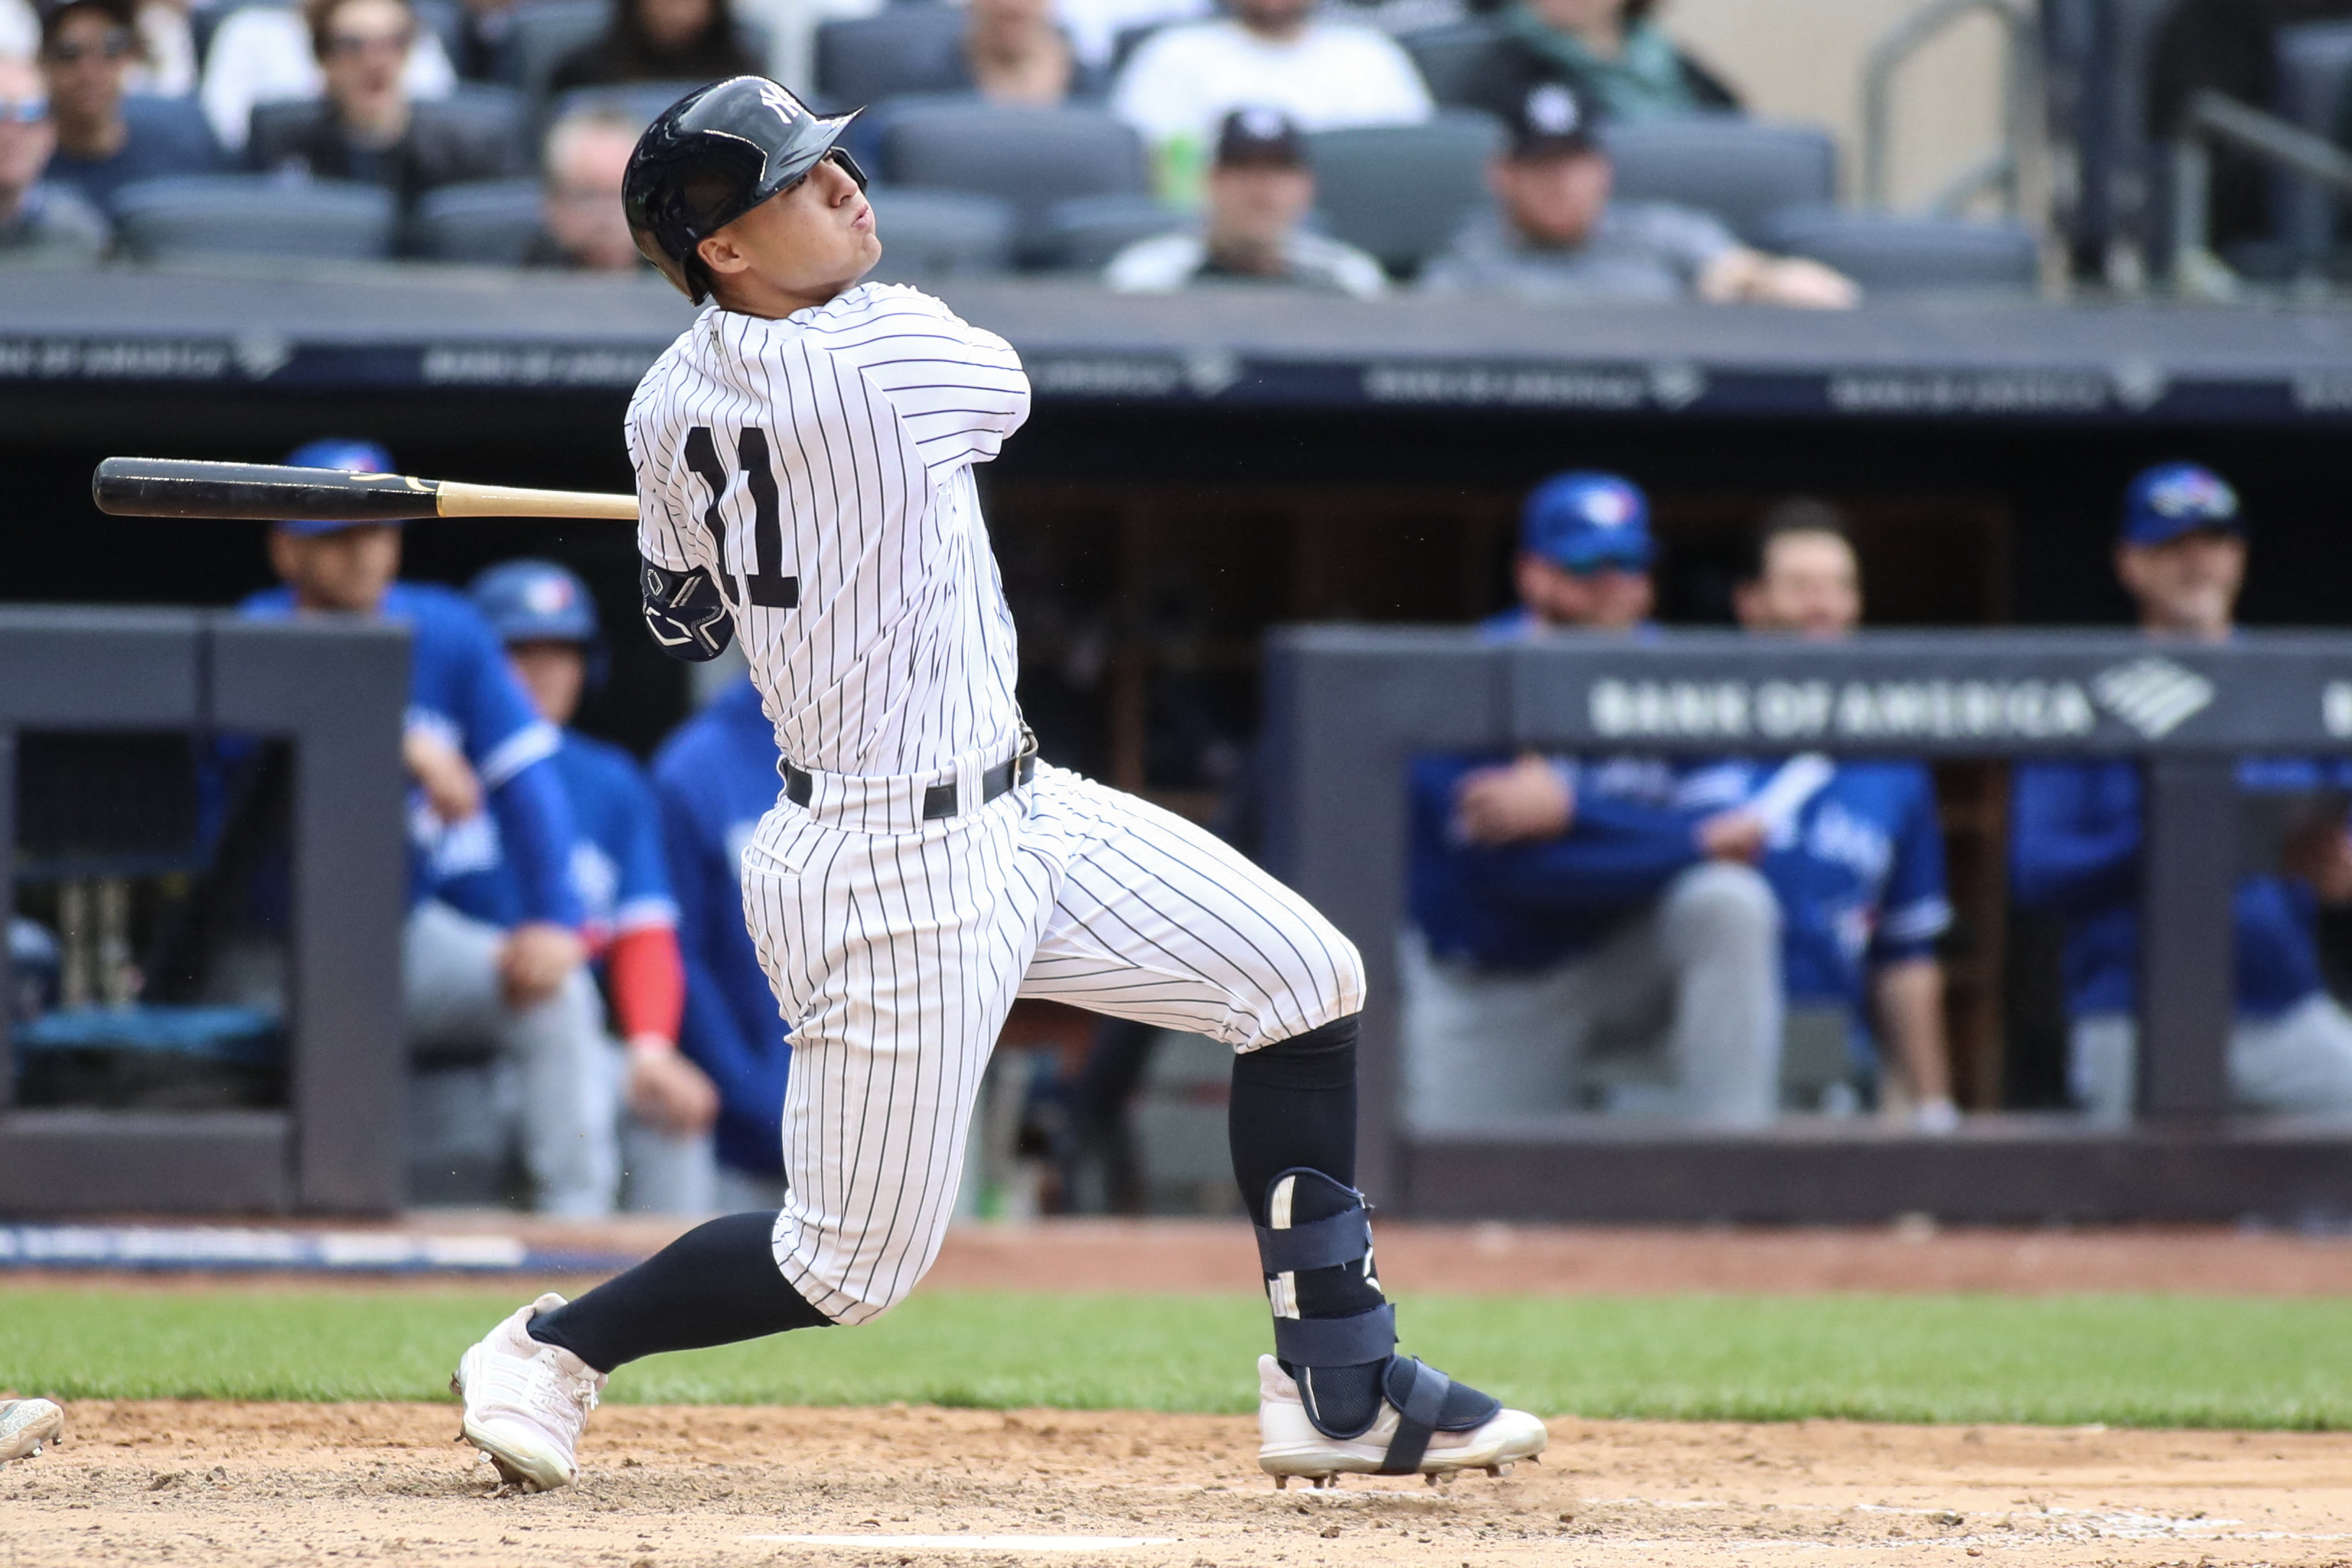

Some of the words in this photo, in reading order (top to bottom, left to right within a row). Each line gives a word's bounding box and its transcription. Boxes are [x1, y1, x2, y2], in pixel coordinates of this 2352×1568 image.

[684, 426, 798, 608] 11
[1590, 679, 1751, 737] BANK
[1755, 679, 1834, 737] OF
[1837, 679, 2096, 737] AMERICA
